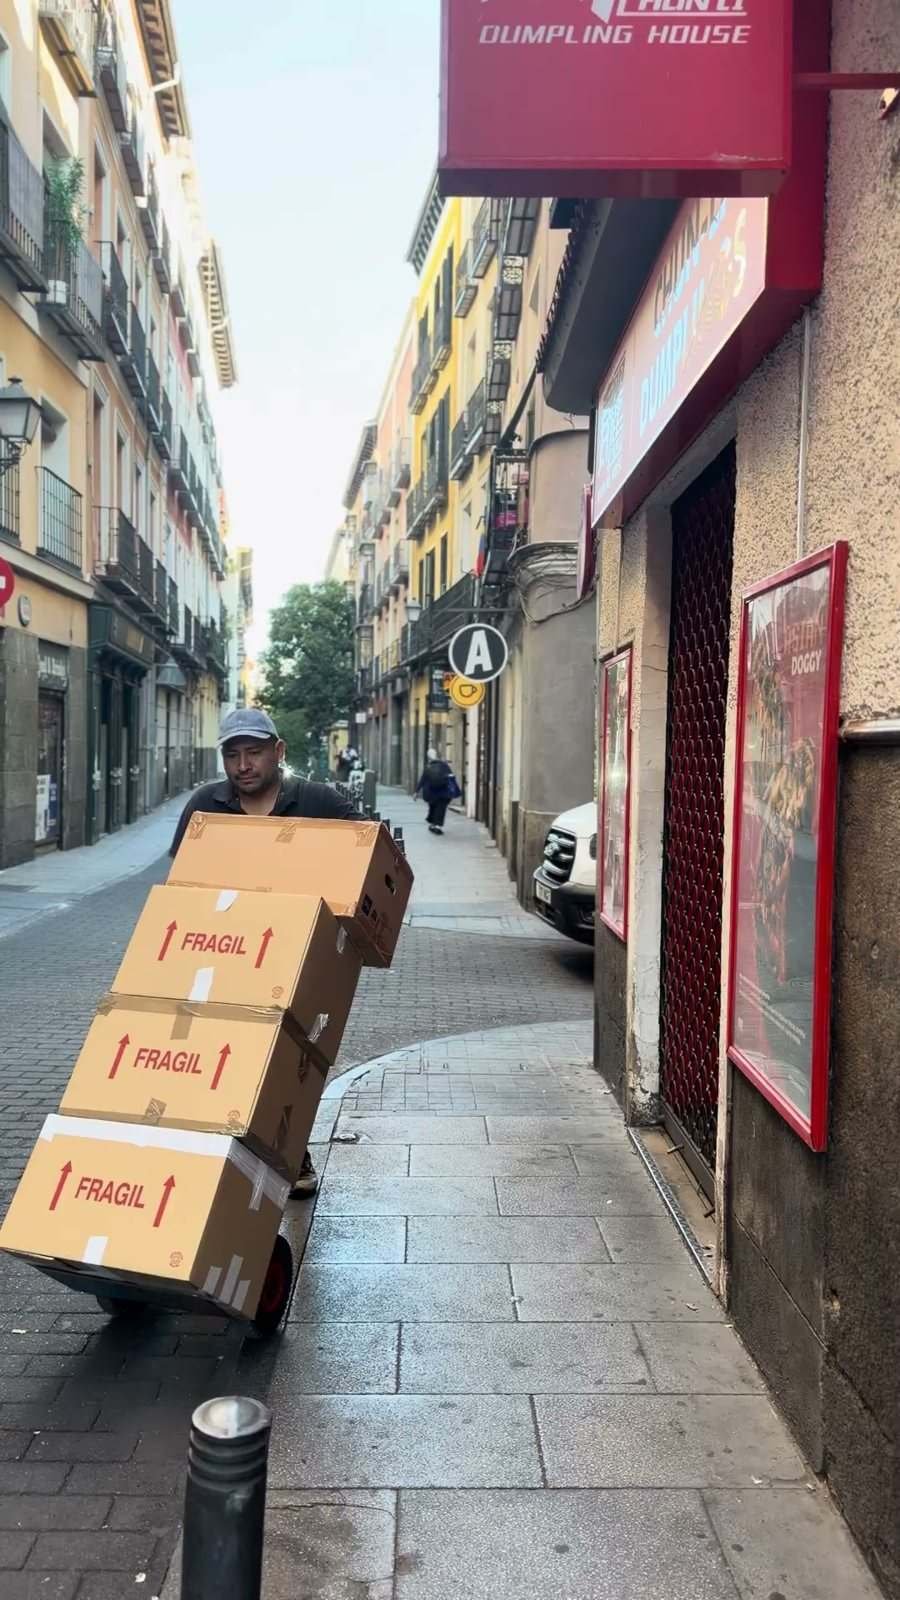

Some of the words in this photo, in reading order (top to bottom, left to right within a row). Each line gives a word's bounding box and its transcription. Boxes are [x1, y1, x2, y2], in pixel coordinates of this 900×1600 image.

[479, 24, 633, 45] DUMPLING
[647, 24, 752, 45] HOUSE
[464, 629, 493, 675] A
[792, 649, 822, 674] DOGGY
[181, 933, 246, 955] FRAGIL
[134, 1048, 202, 1074] FRAGIL
[75, 1178, 145, 1208] FRAGIL
